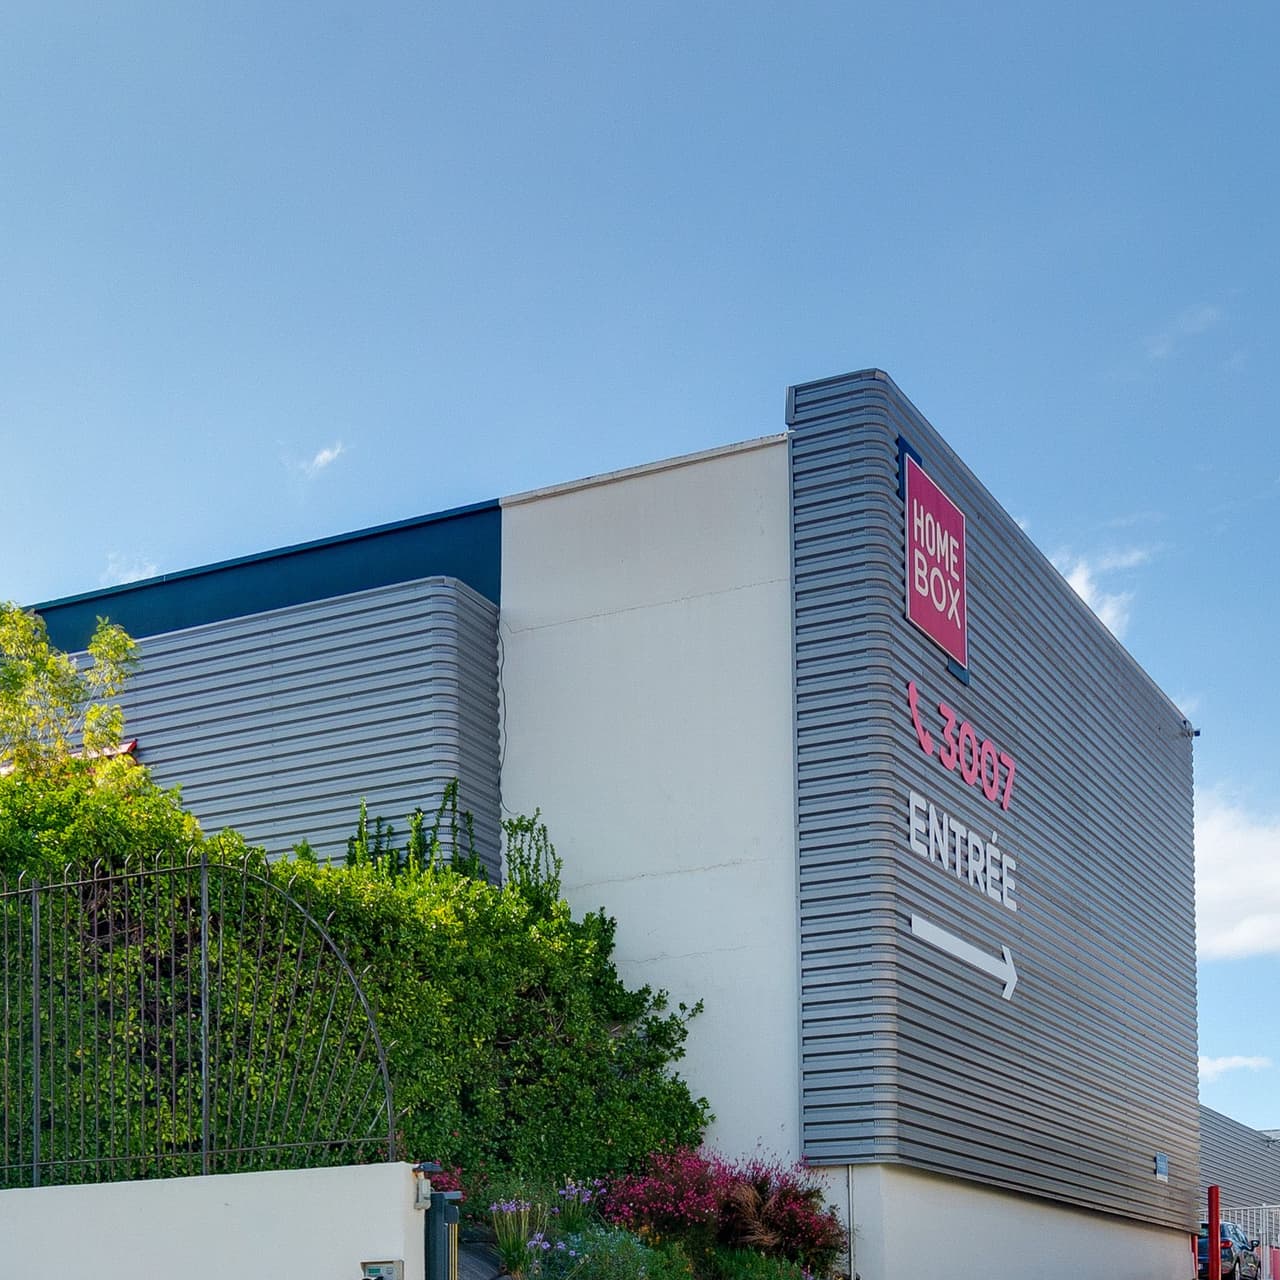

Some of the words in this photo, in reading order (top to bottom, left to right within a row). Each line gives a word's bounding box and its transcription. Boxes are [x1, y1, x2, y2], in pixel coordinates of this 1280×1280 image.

[913, 498, 960, 582] HOME
[913, 548, 961, 630] BOX
[938, 702, 1016, 811] 3007
[909, 790, 1018, 912] ENTRÉE
